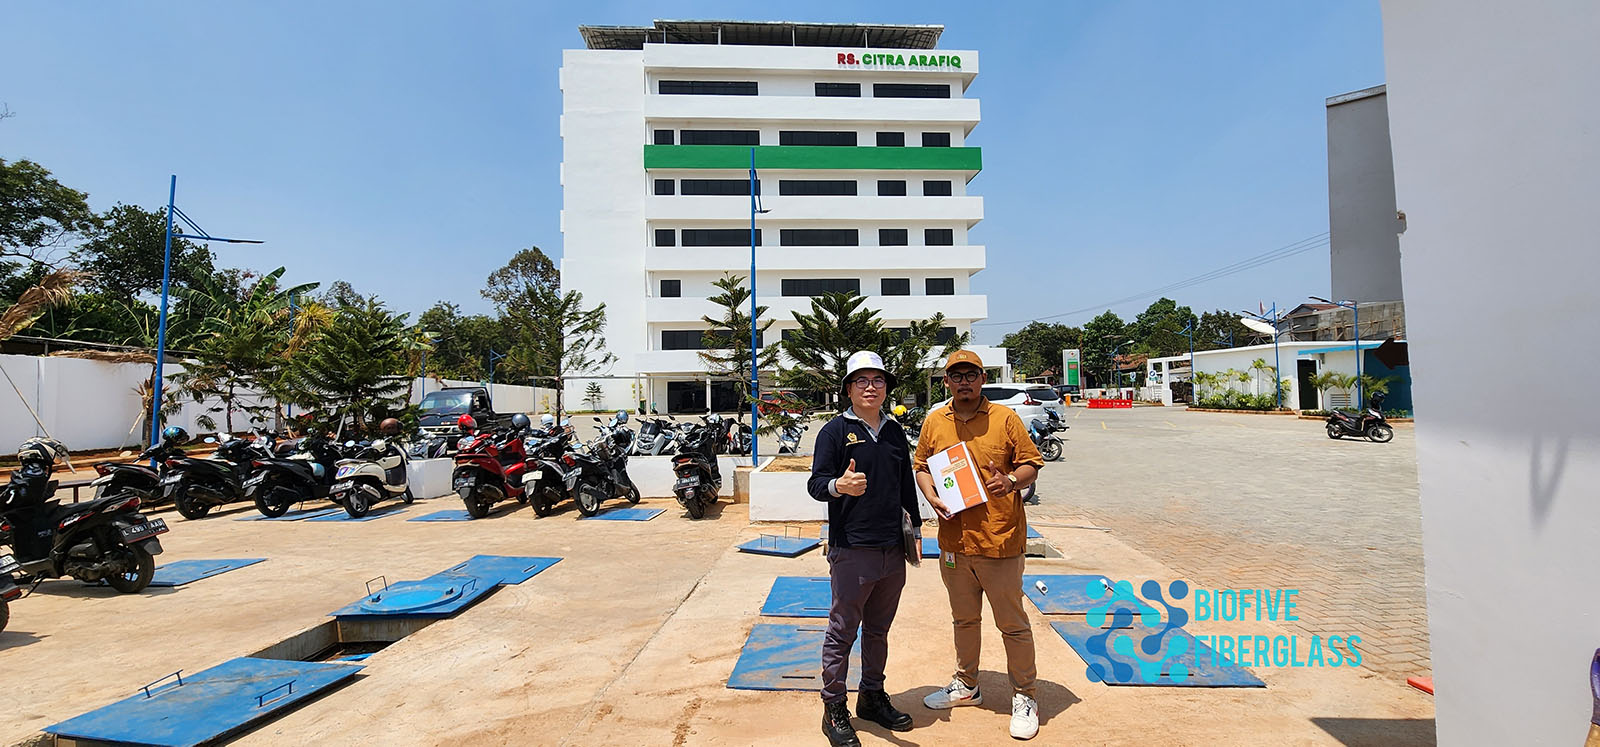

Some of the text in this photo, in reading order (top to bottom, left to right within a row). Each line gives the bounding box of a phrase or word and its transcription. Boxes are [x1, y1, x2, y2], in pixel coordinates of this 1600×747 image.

[837, 53, 962, 68] RS. CITRA ARAFIQ
